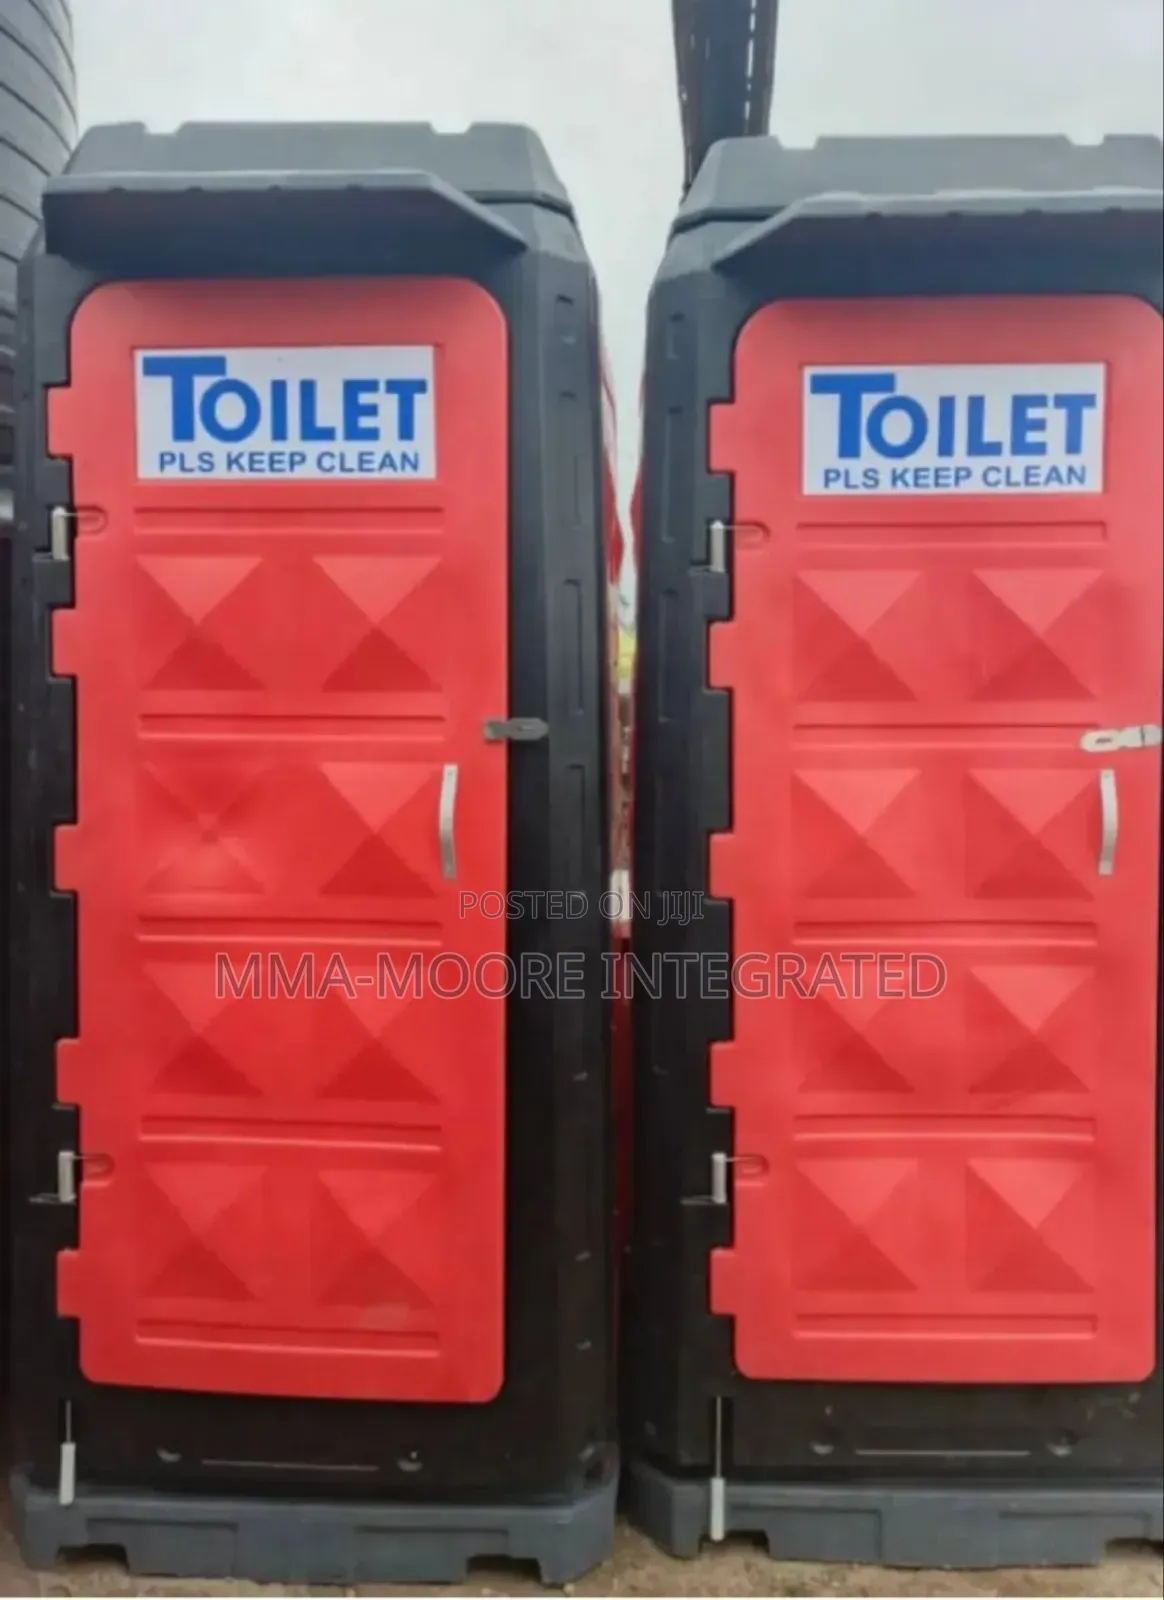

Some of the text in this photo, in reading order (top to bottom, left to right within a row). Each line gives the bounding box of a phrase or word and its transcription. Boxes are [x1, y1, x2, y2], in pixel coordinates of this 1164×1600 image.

[142, 356, 427, 443] TOILET
[810, 373, 1096, 459] TOILET
[159, 450, 420, 473] PLS KEEP CLEAN
[823, 465, 1087, 489] PLS KEEP CLEAN
